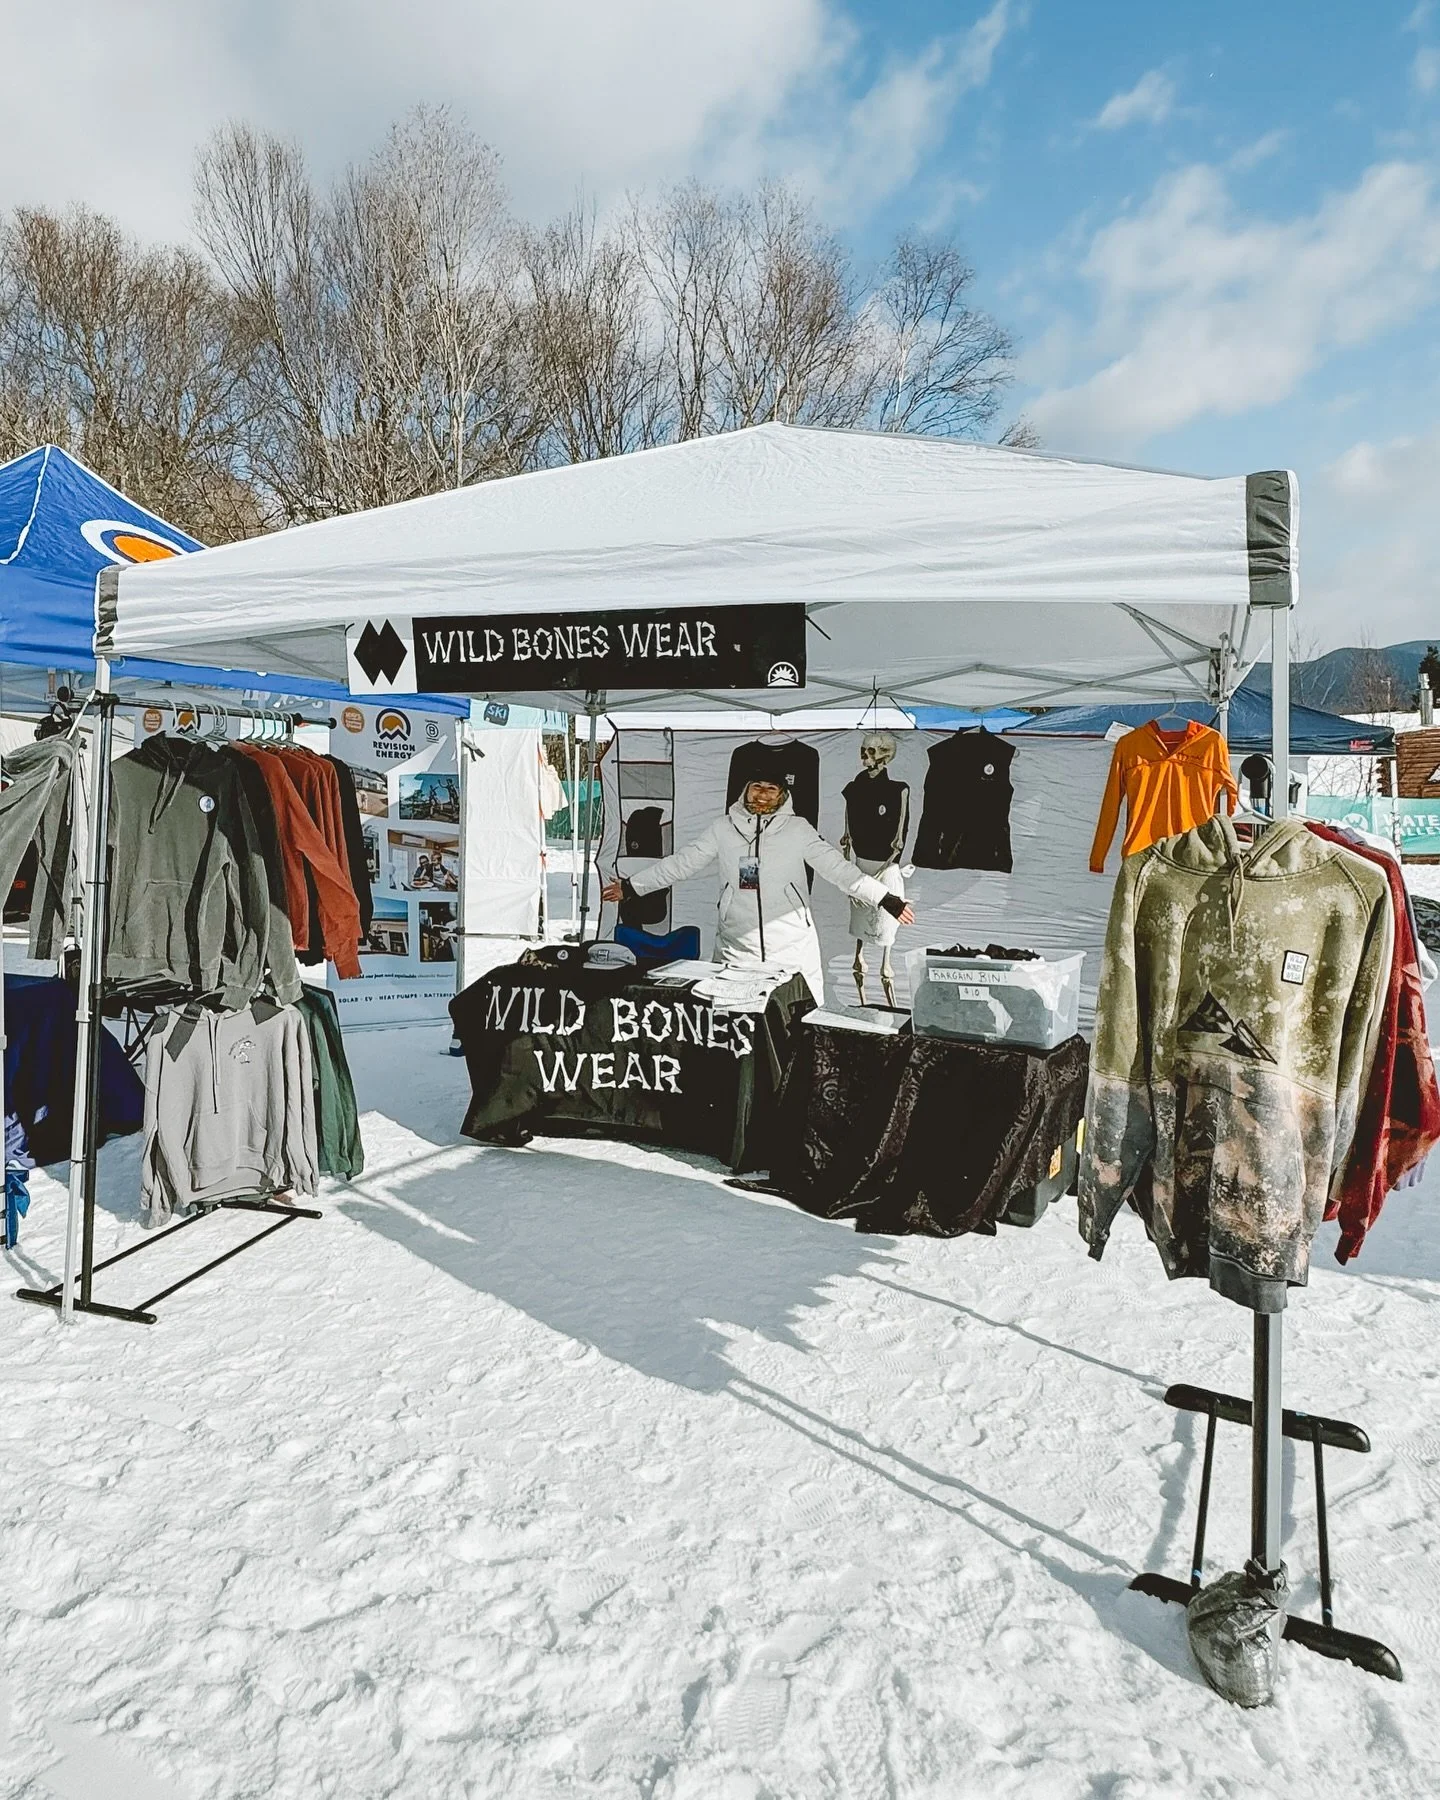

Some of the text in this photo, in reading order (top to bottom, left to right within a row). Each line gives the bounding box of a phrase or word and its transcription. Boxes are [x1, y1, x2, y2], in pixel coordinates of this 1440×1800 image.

[422, 620, 718, 664] WILD BONES WEAR
[487, 705, 507, 720] SKI
[372, 741, 416, 752] REVISION
[375, 750, 412, 760] ENERGY
[932, 969, 973, 981] BARGAIN
[485, 985, 755, 1059] WILD BONES
[533, 1050, 683, 1094] WEAR
